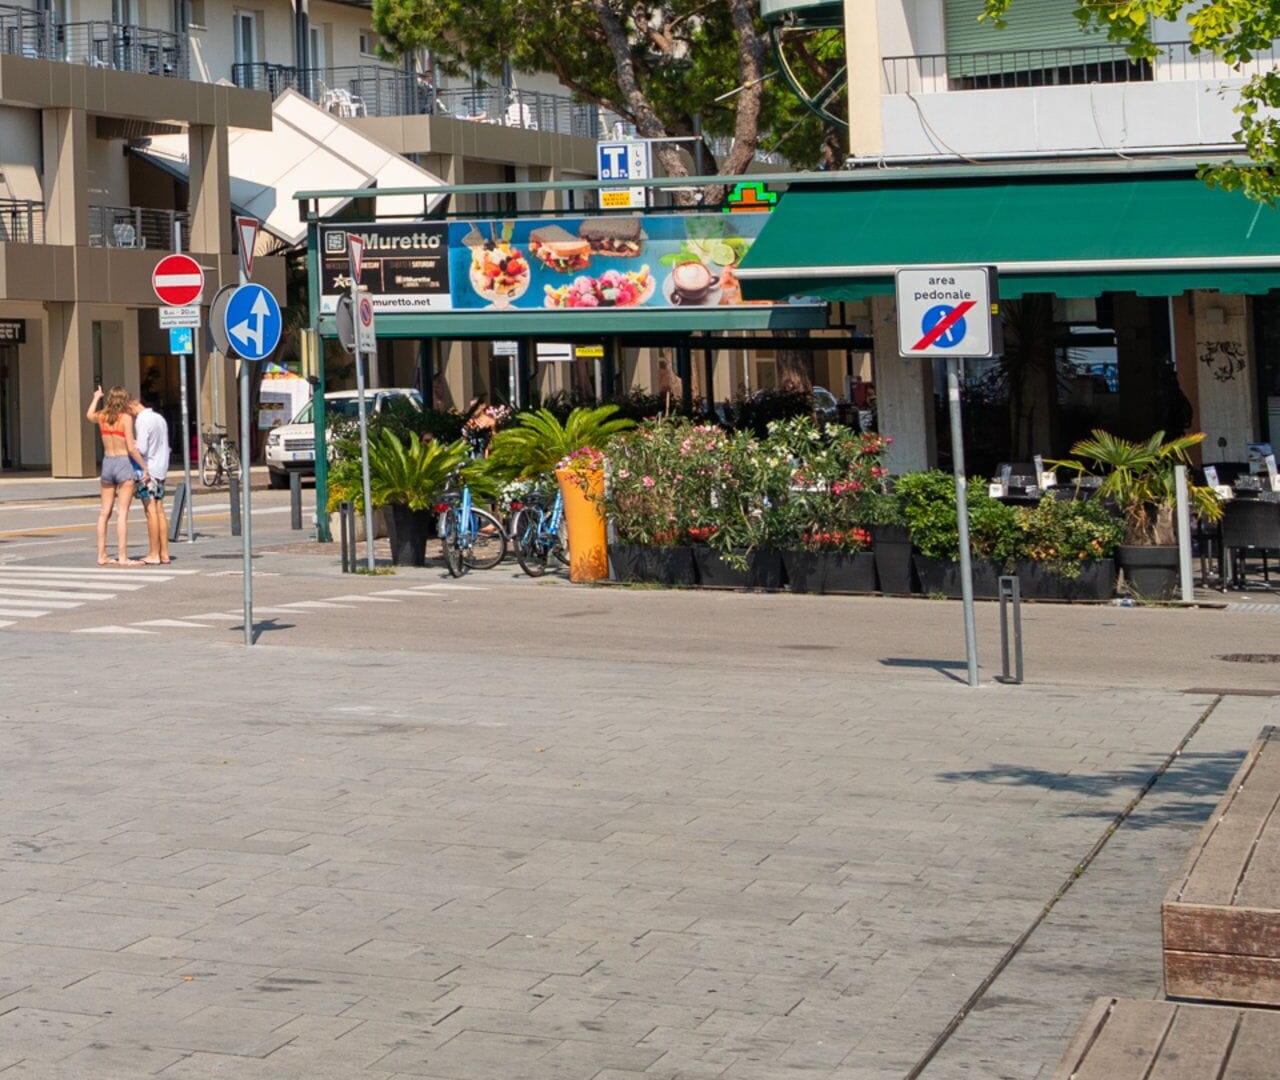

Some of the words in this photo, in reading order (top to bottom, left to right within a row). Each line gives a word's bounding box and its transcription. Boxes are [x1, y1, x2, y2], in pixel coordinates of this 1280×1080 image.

[360, 232, 440, 250] Muretto
[928, 276, 956, 285] area
[914, 289, 972, 301] pedonale
[372, 298, 431, 307] muretto.net
